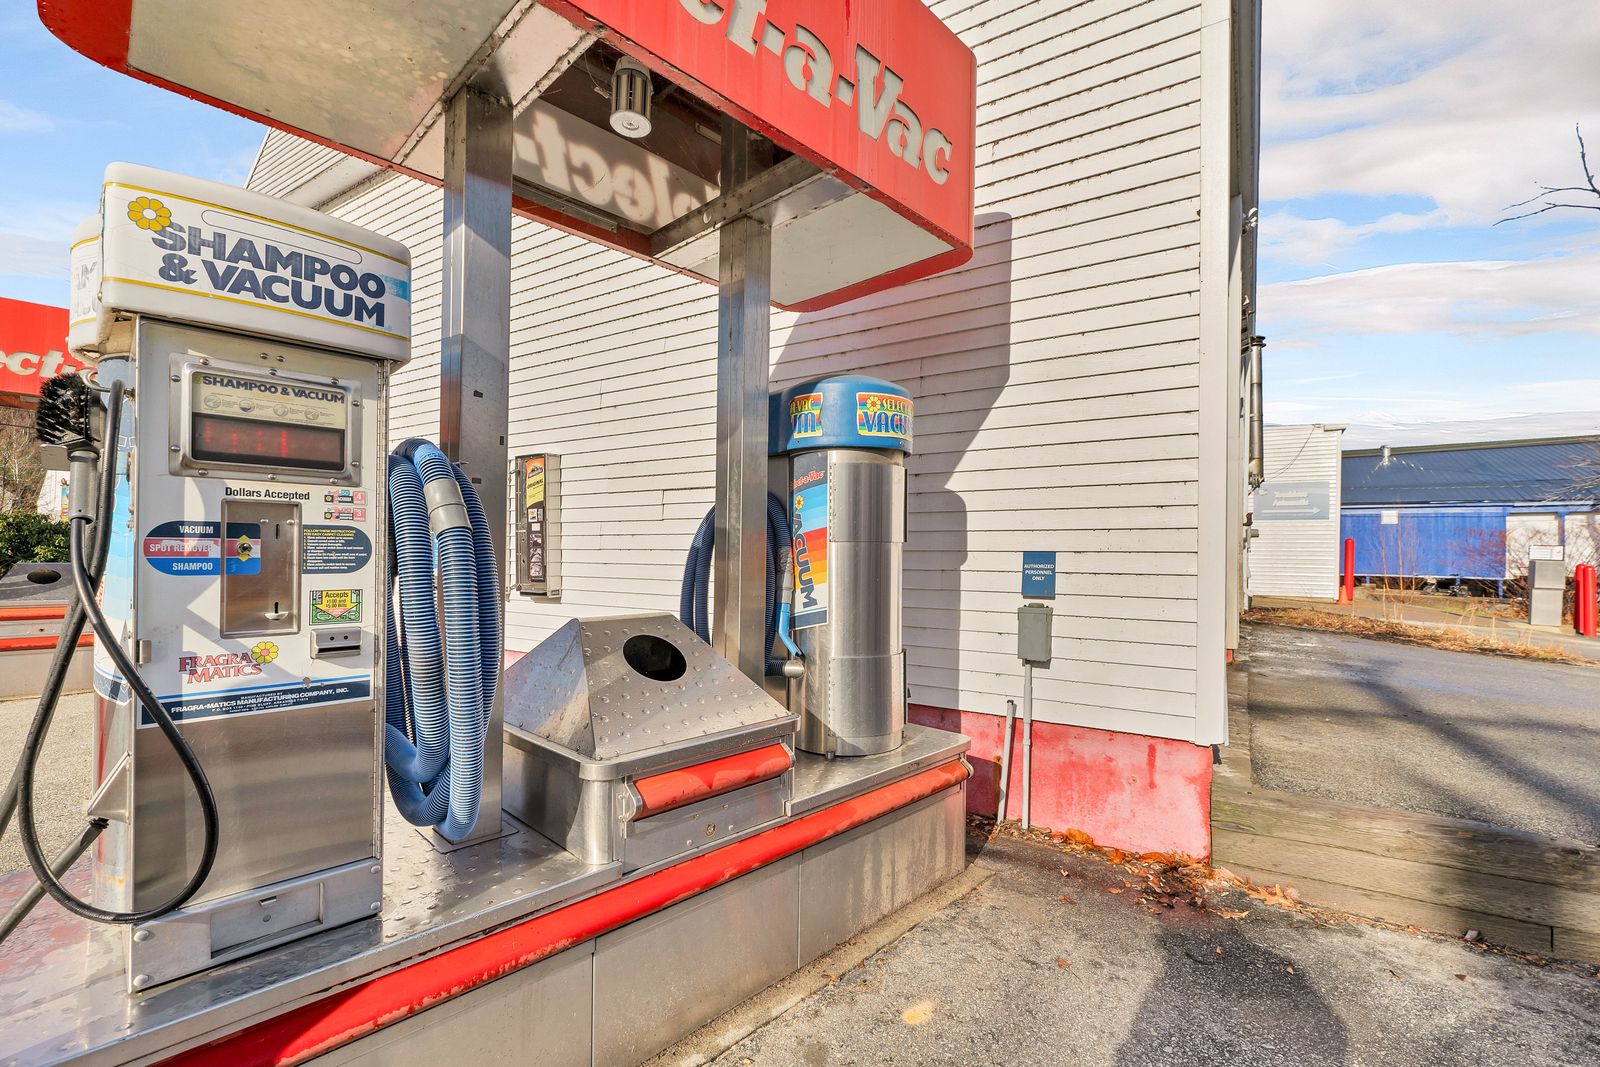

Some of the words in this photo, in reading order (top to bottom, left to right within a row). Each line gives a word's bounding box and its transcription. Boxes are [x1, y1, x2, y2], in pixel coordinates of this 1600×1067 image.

[152, 222, 386, 299] SHAMPOO
[158, 253, 198, 285] &
[201, 259, 385, 327] VACUUM
[202, 376, 278, 394] SHAMPOO
[280, 387, 290, 396] &
[292, 389, 345, 404] VACUUM
[225, 487, 262, 498] Dollars
[264, 489, 310, 501] Accepted
[179, 525, 214, 534] VACUUM
[149, 543, 171, 552] SPOT
[172, 562, 213, 571] SHAMPOO
[325, 591, 349, 599] Accepts
[178, 652, 253, 672] FRAGRA
[187, 663, 263, 684] MATICS
[237, 693, 300, 706] MANUFACTURING
[300, 689, 335, 698] COMPANY,
